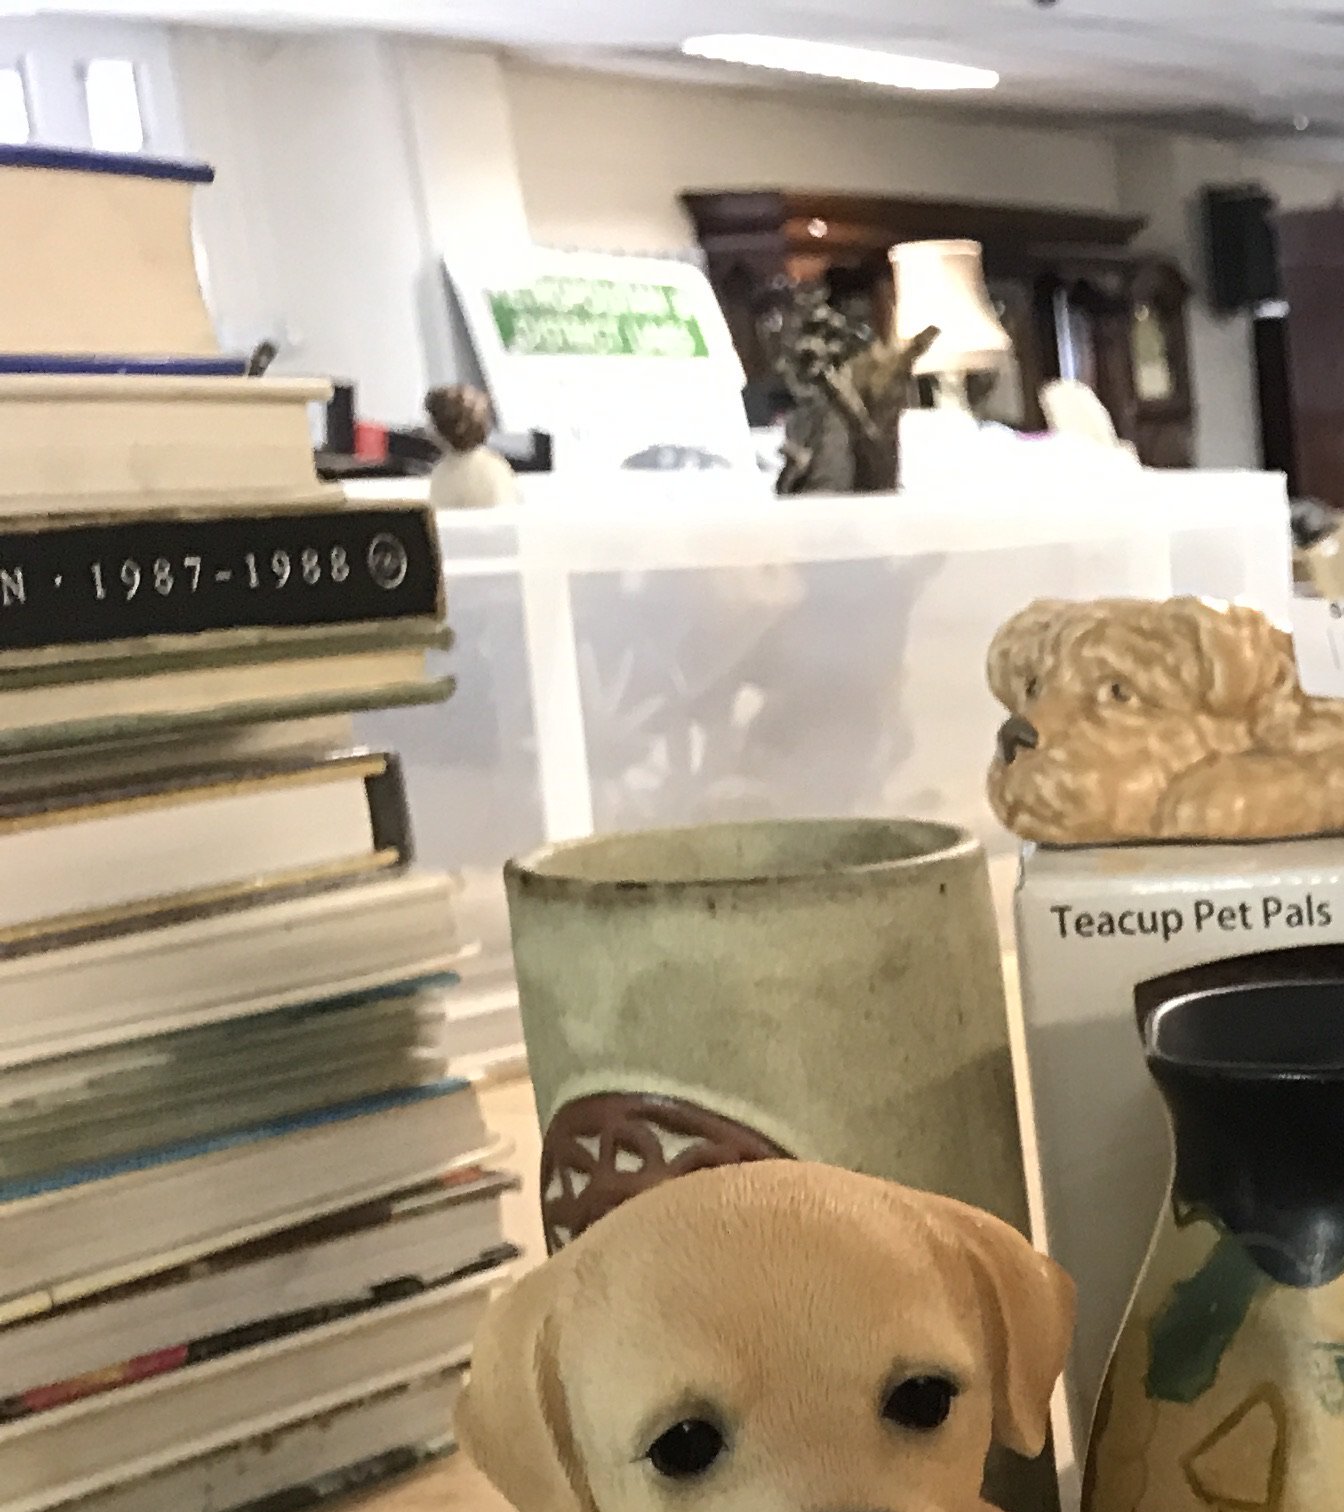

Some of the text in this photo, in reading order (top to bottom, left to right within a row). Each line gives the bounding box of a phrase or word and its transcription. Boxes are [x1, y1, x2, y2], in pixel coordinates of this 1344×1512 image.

[90, 545, 351, 602] 1987-1988
[1050, 893, 1332, 943] Teacup Pet Pals
